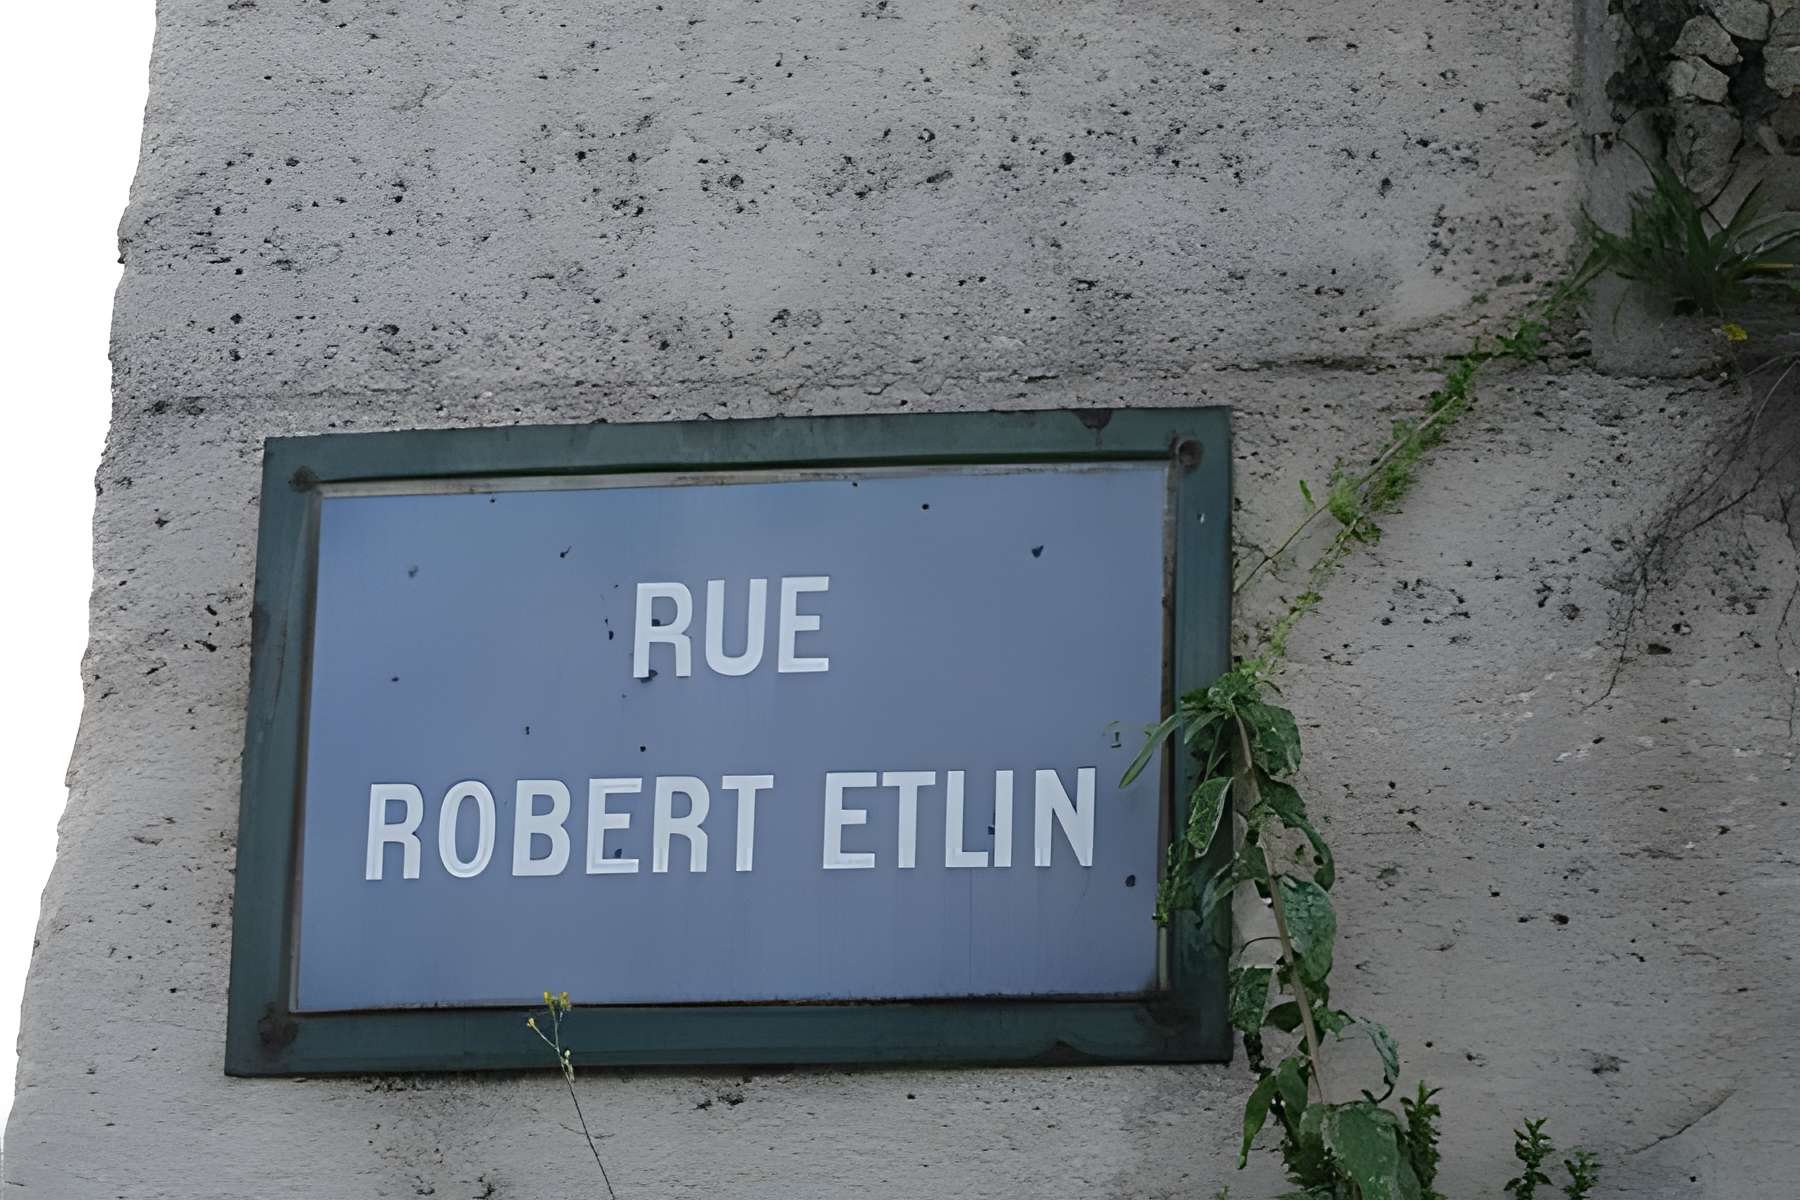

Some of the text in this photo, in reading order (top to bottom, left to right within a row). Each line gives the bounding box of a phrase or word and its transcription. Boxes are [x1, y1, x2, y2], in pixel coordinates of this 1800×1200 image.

[632, 576, 831, 679] RUE
[364, 767, 1097, 881] ROBERT ETLIN
